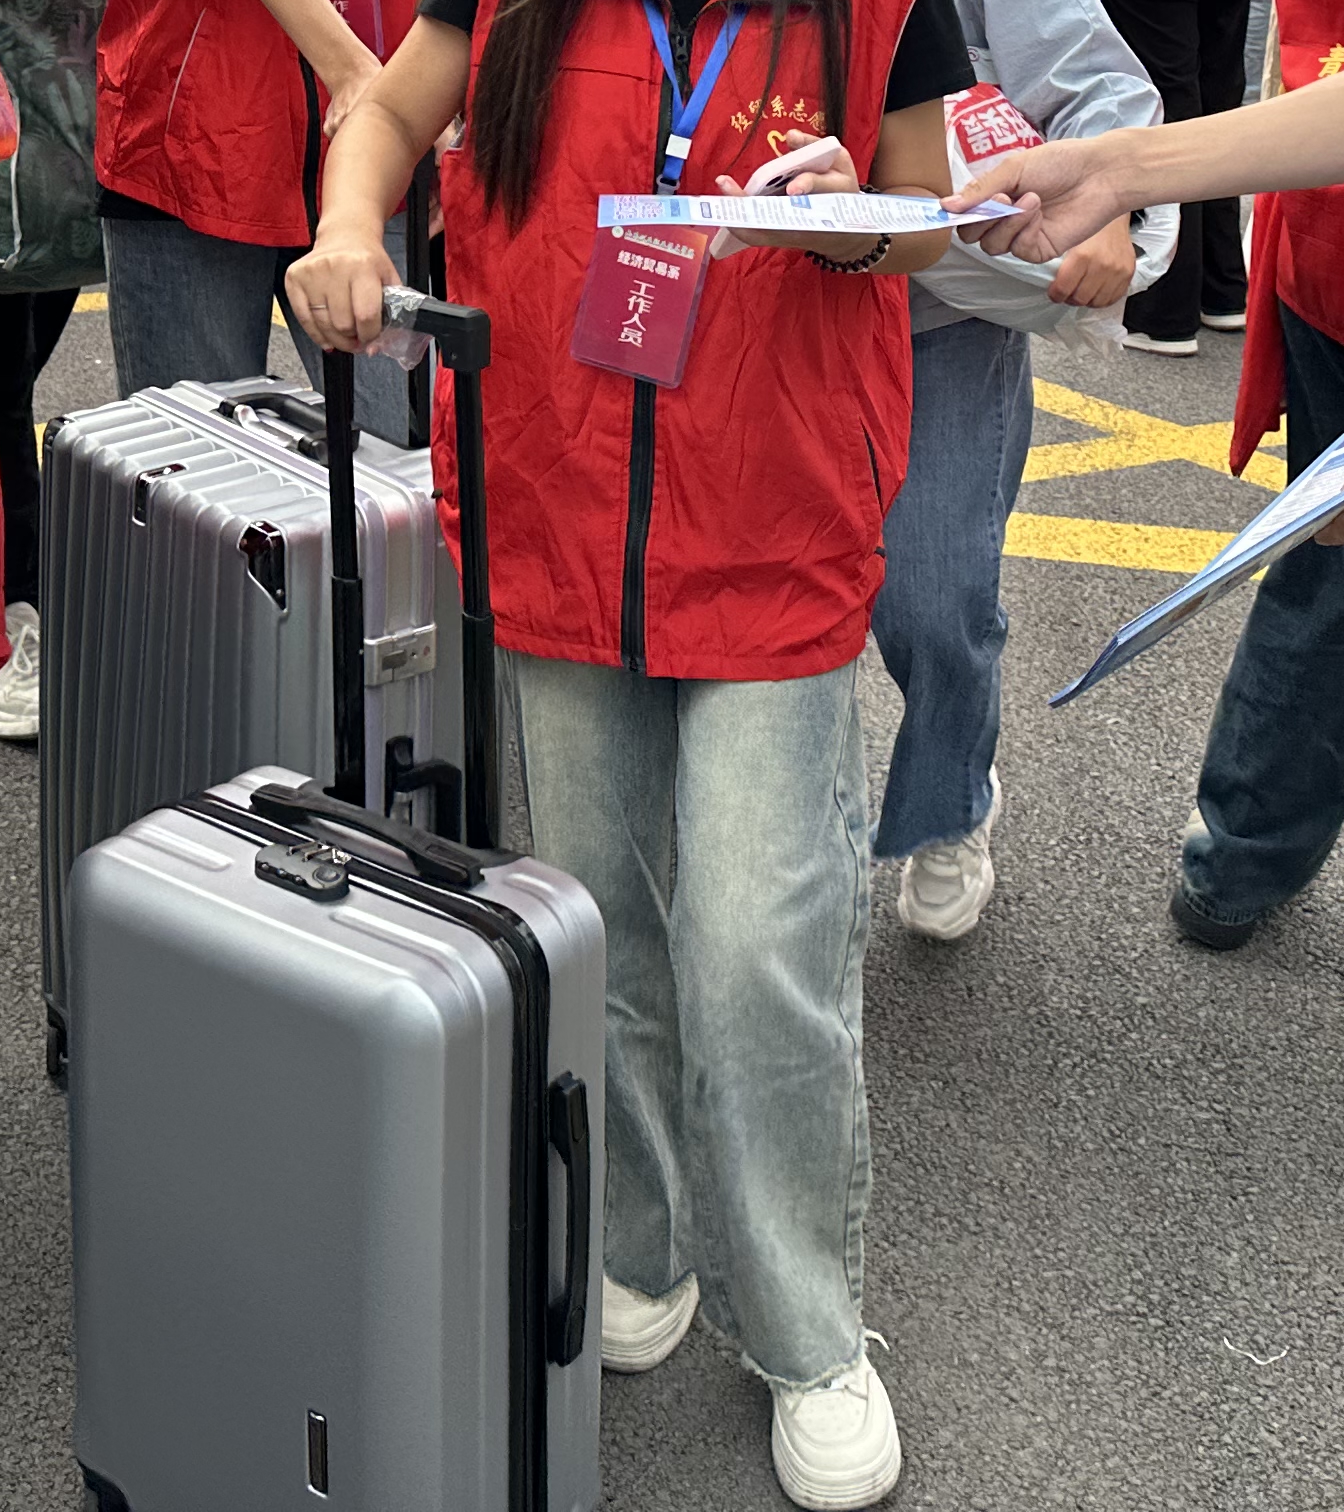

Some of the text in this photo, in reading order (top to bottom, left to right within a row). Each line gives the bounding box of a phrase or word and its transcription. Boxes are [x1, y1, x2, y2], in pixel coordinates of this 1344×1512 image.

[617, 250, 681, 281] 经济贸易系
[618, 279, 655, 348] 工作人员
